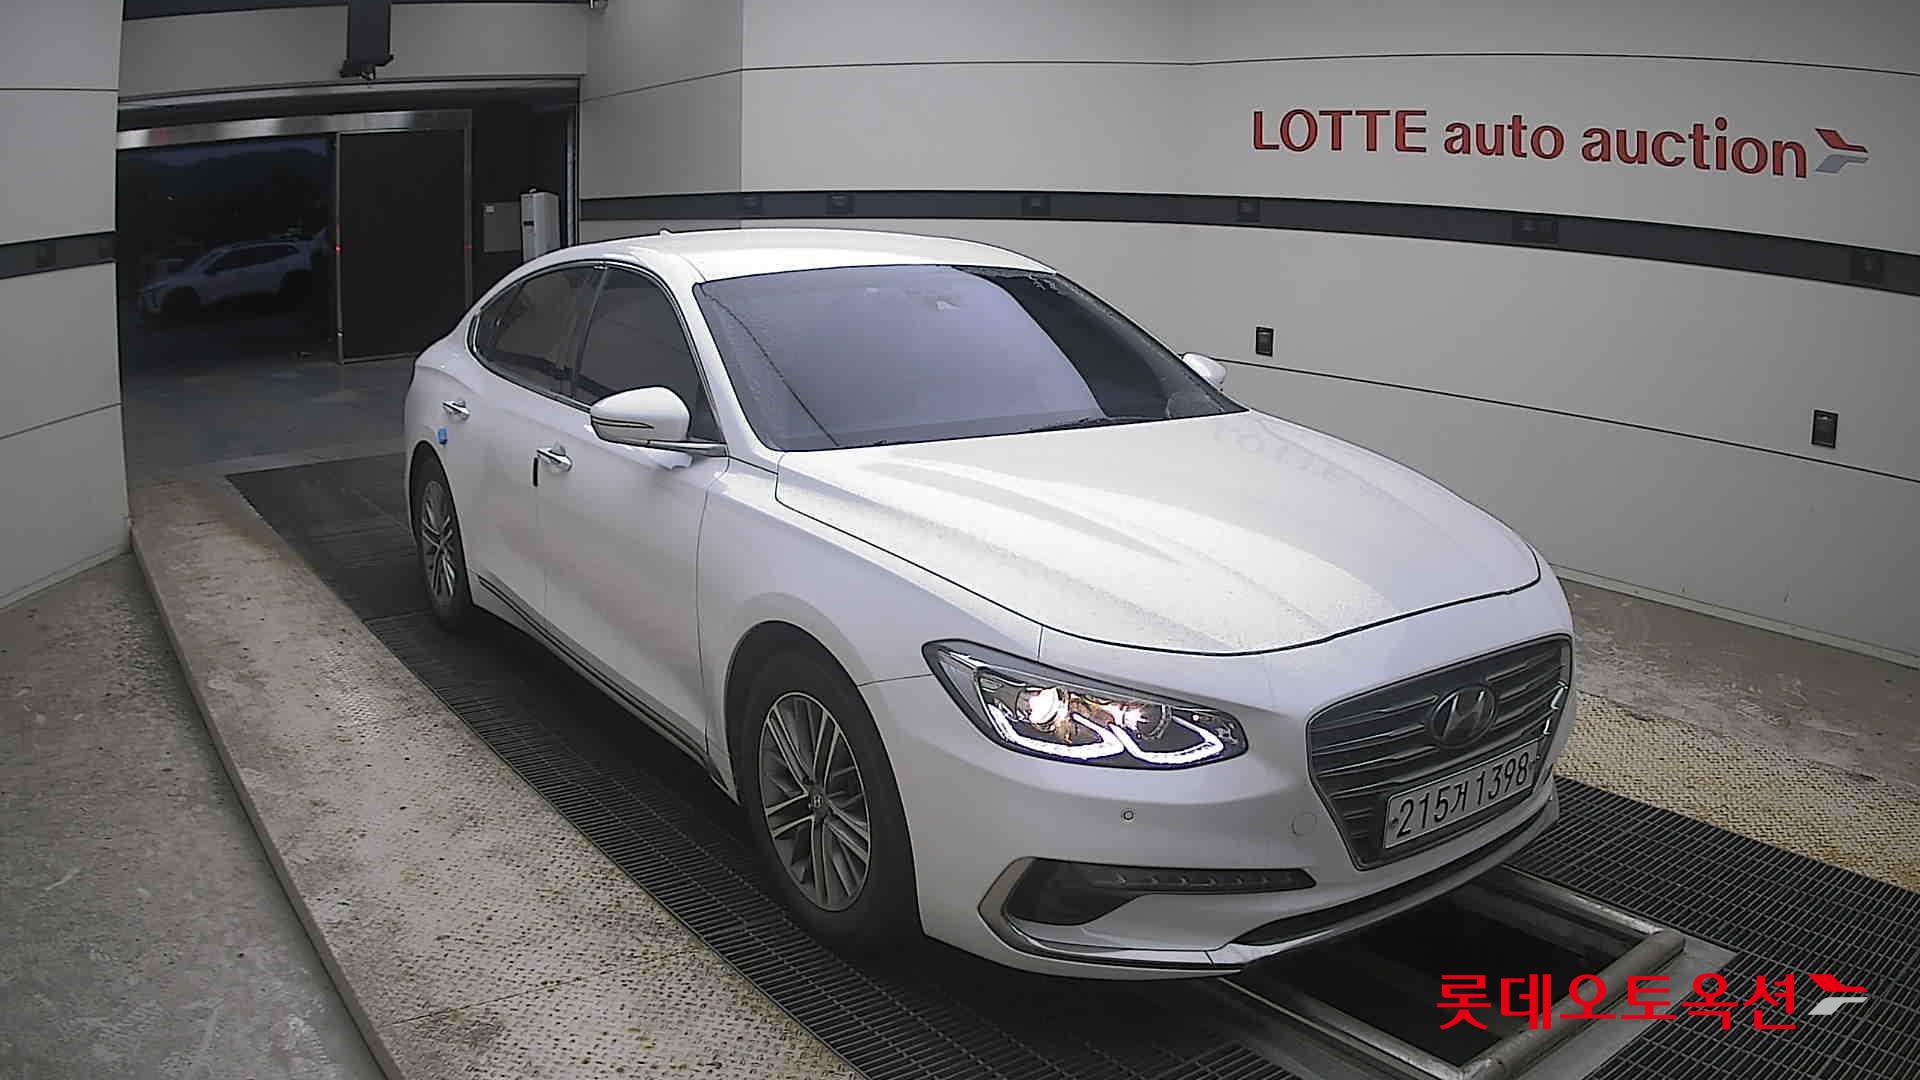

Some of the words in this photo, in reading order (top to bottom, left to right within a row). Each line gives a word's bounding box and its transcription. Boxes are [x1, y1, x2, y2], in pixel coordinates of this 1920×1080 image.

[1252, 109, 1428, 153] LOTTE
[1442, 114, 1566, 159] auto
[1581, 117, 1808, 179] auction
[1476, 751, 1530, 806] 1398
